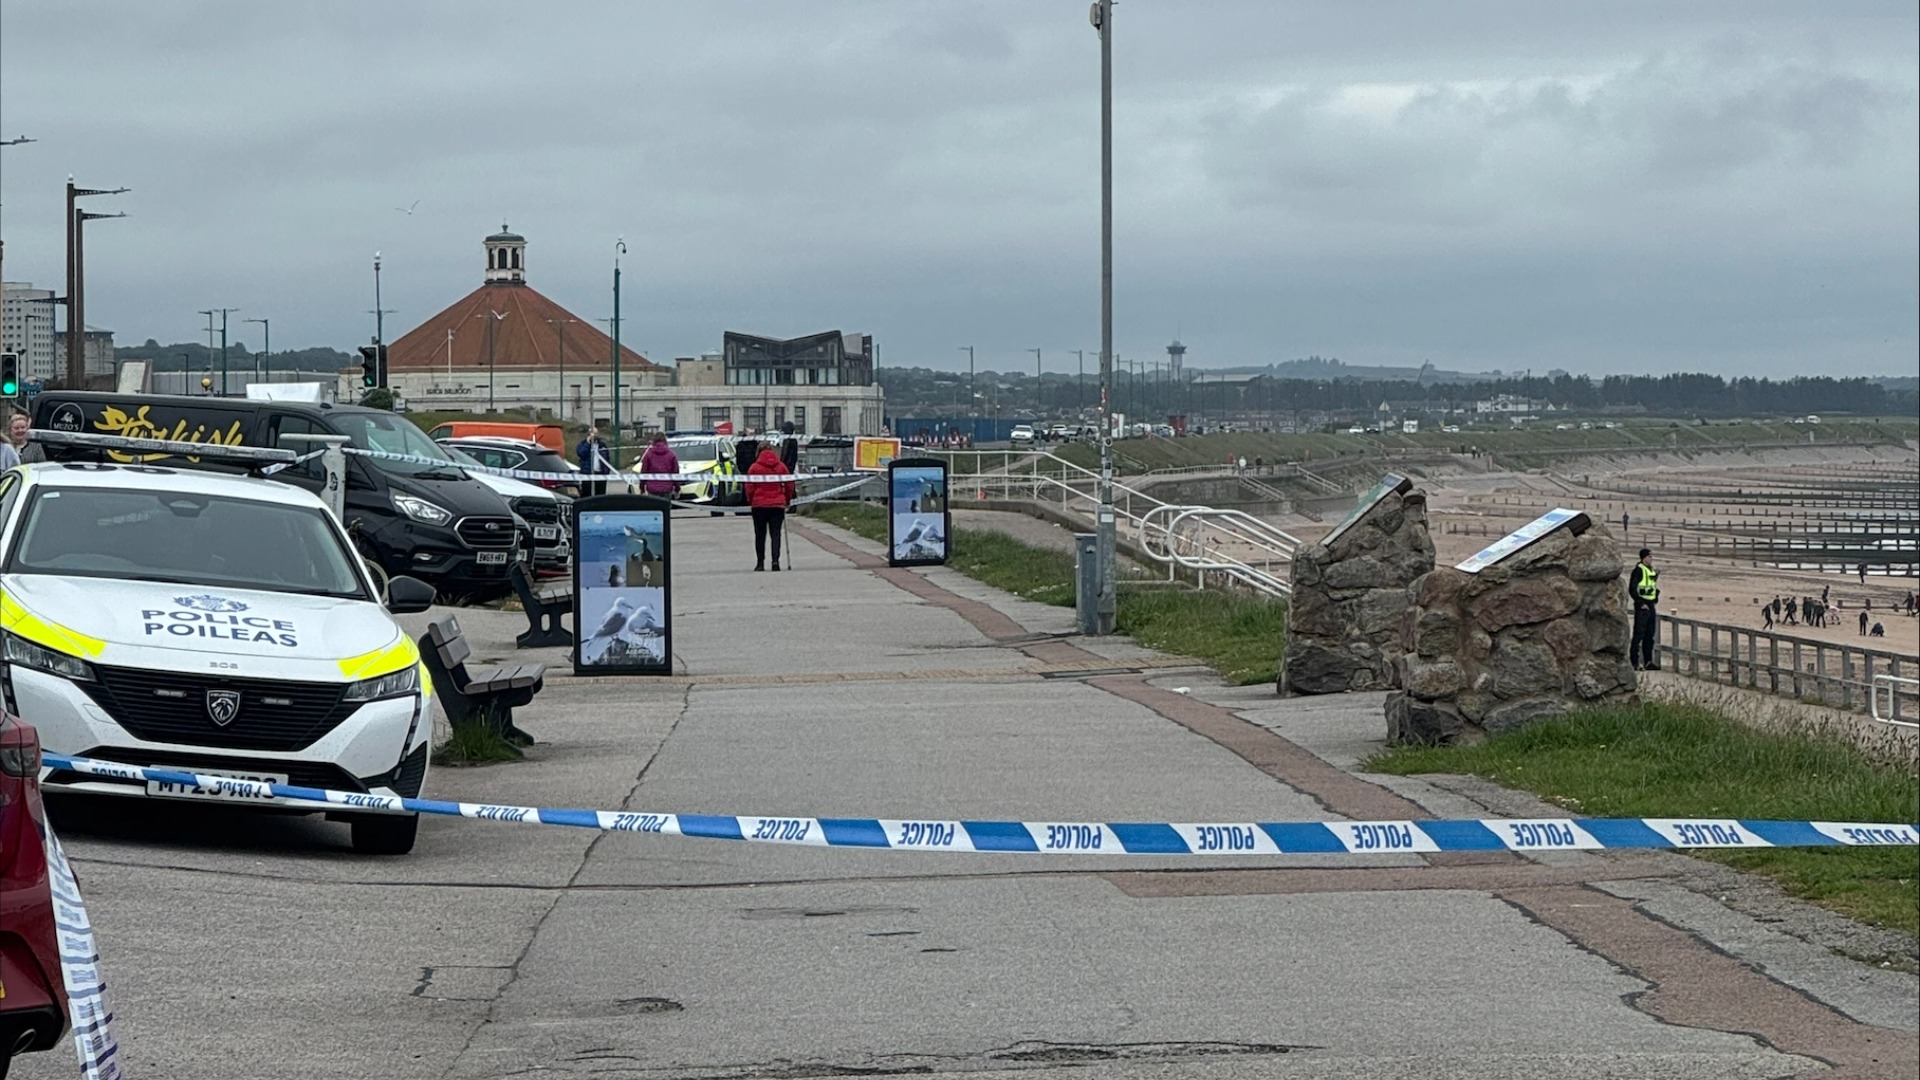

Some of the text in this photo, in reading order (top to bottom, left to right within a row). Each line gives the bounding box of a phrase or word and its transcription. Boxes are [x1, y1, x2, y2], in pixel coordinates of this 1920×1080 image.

[142, 609, 296, 632] POLICE
[144, 622, 298, 648] POILEAS
[475, 806, 530, 823] POLICE
[610, 814, 669, 833] POLICE
[752, 819, 811, 841] POLICE
[897, 822, 955, 846] POLICE
[1046, 825, 1102, 849] POLICE
[1196, 826, 1255, 850] POLICE
[1351, 824, 1413, 849] POLICE
[1509, 823, 1576, 846] POLICE
[1672, 823, 1744, 845] POLICE
[1843, 828, 1915, 844] POLICE
